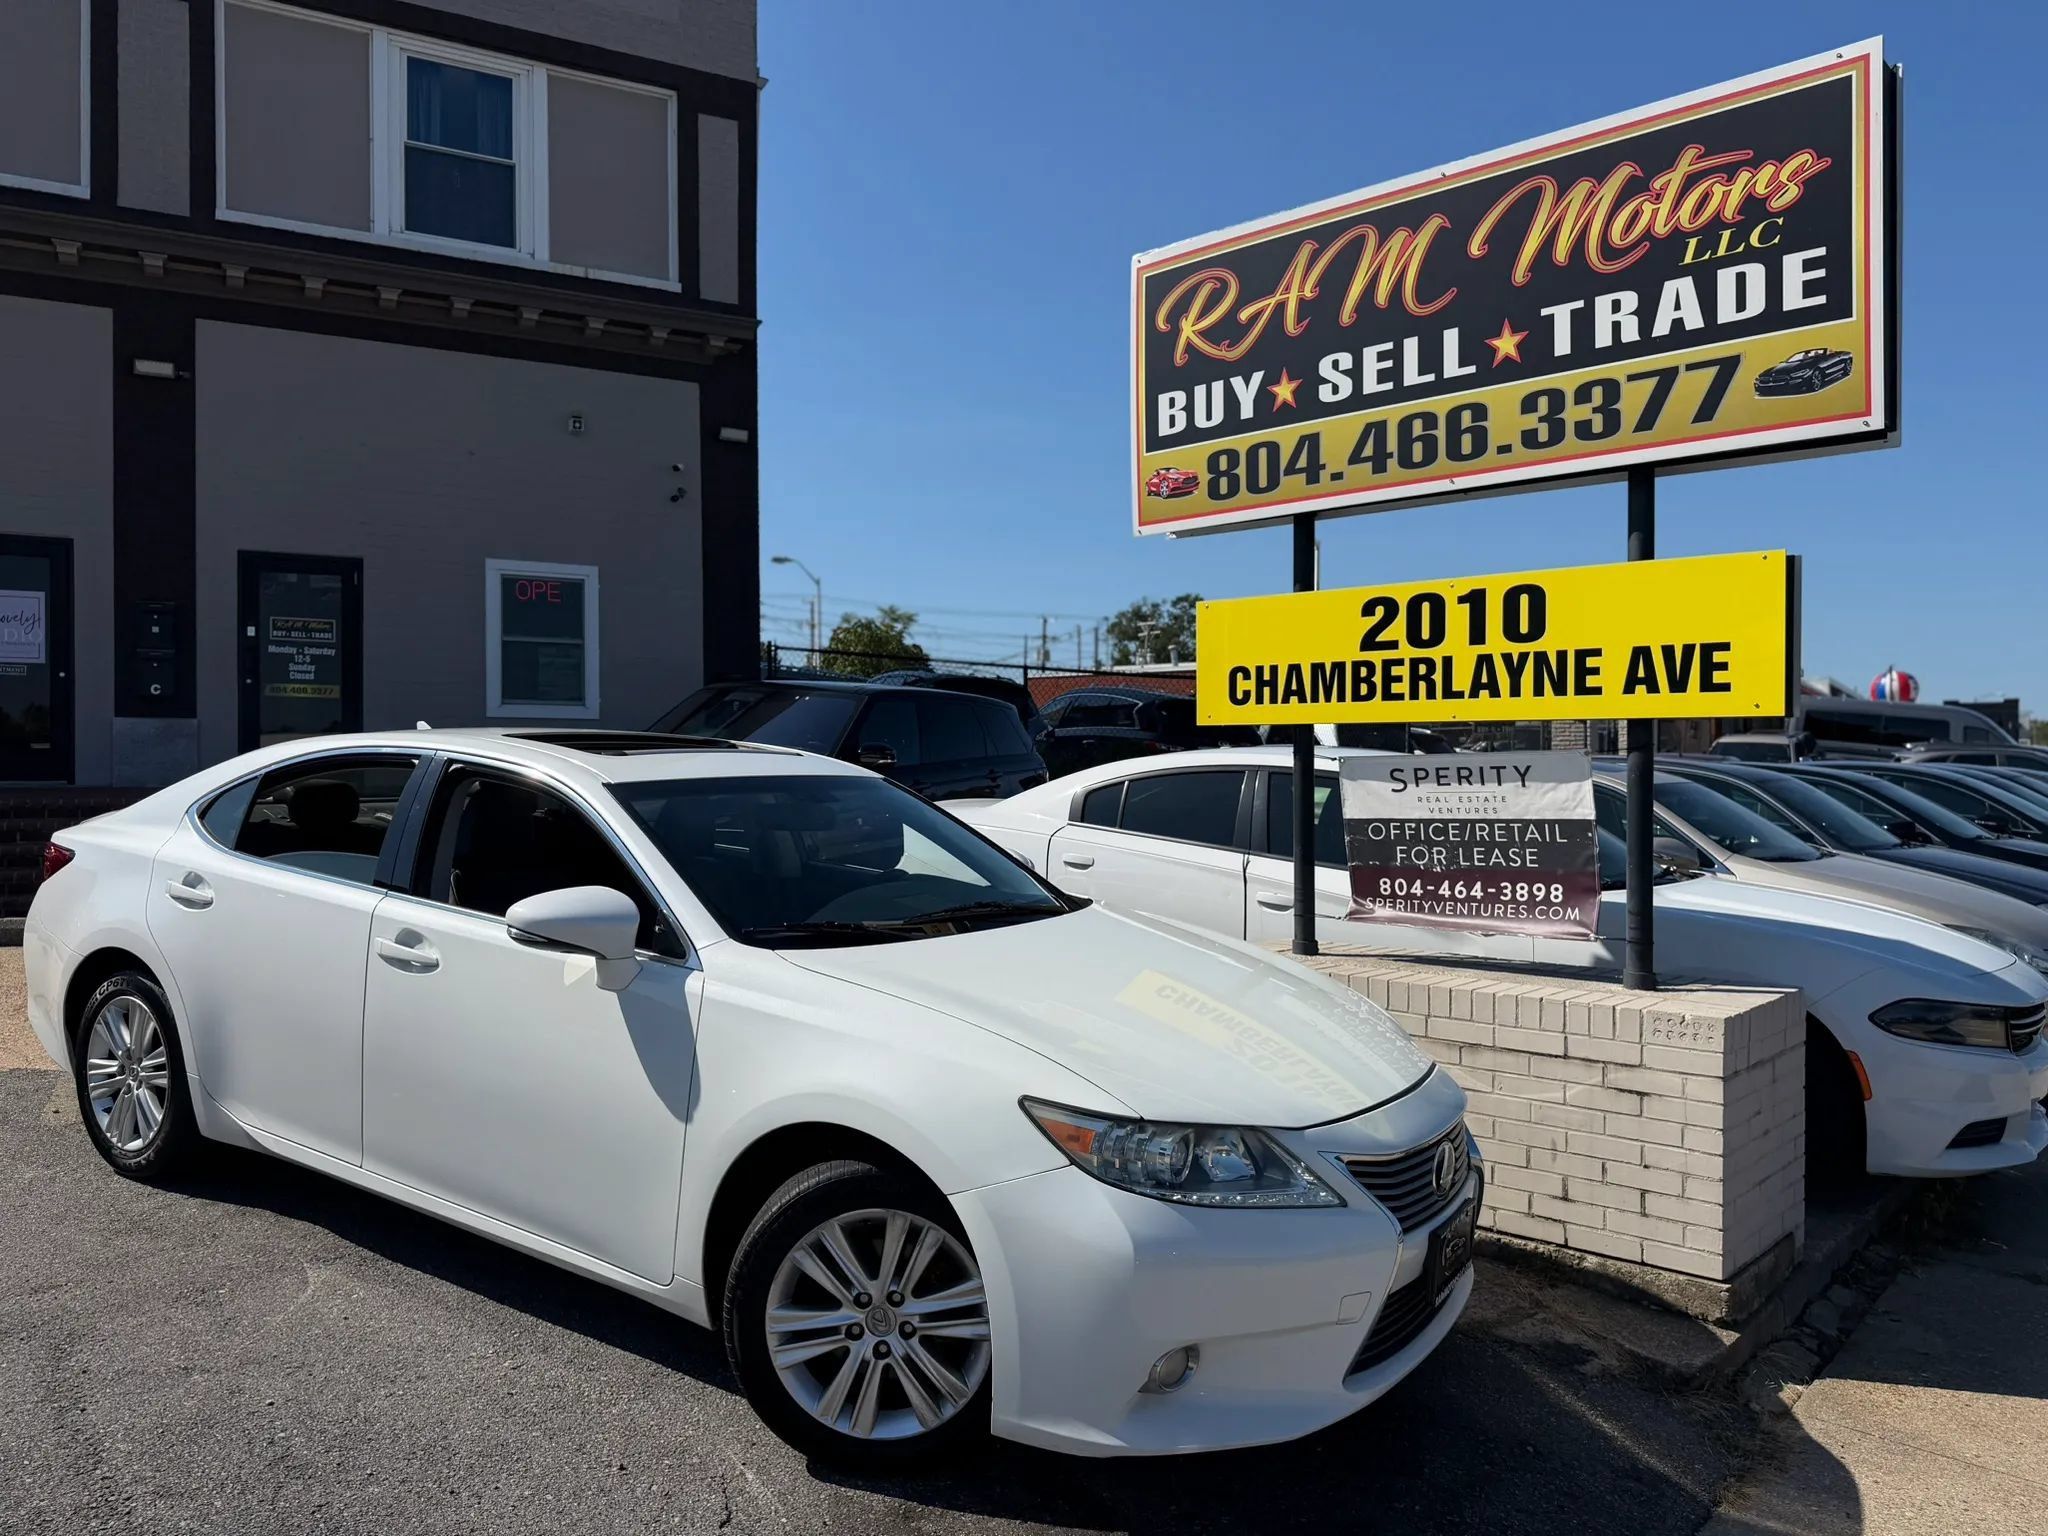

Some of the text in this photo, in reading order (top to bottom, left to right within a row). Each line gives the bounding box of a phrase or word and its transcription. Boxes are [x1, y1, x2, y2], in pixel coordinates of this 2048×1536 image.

[1679, 216, 1784, 268] LLC
[1154, 143, 1831, 366] RAM Motors
[1157, 246, 1828, 437] BUY SELL TRADE
[1206, 353, 1746, 502] 804.466.3377
[1359, 583, 1548, 653] 2010
[268, 644, 336, 656] Monday Saturday
[288, 663, 316, 672] Sunday
[289, 671, 315, 680] Closed
[1228, 641, 1732, 707] CHAMBERLAYNE AVE
[150, 684, 161, 695] C
[1389, 765, 1533, 793] SPERITY
[1417, 795, 1507, 804] REAL ESTATE
[1428, 806, 1498, 815] VENTURES
[1367, 822, 1568, 843] OFFICE/RETAIL
[1396, 846, 1539, 868] FOR LEASE
[1379, 877, 1564, 903] 804-464-3898
[1365, 897, 1581, 921] SPERITYVENTURES.COM
